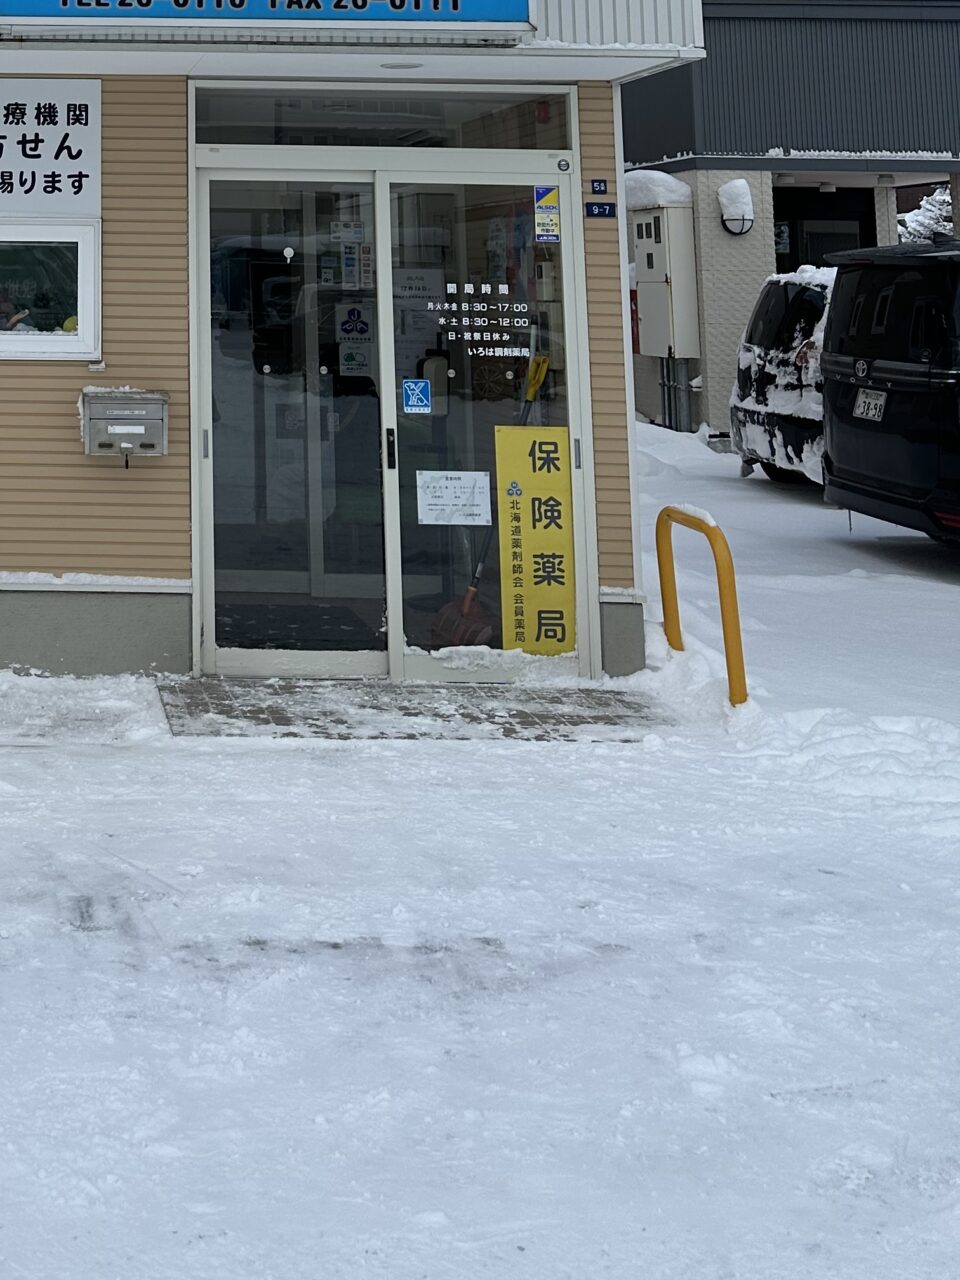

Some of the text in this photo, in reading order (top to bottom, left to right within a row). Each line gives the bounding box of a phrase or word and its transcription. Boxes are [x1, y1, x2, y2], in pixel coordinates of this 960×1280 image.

[592, 205, 610, 215] 9-7
[446, 283, 509, 295] 開局時間
[467, 347, 530, 357] いろは調剤薬局
[836, 374, 892, 388] VOXY
[528, 440, 567, 643] 保険薬局
[509, 499, 526, 643] 北海道薬剤師会 会員薬局
